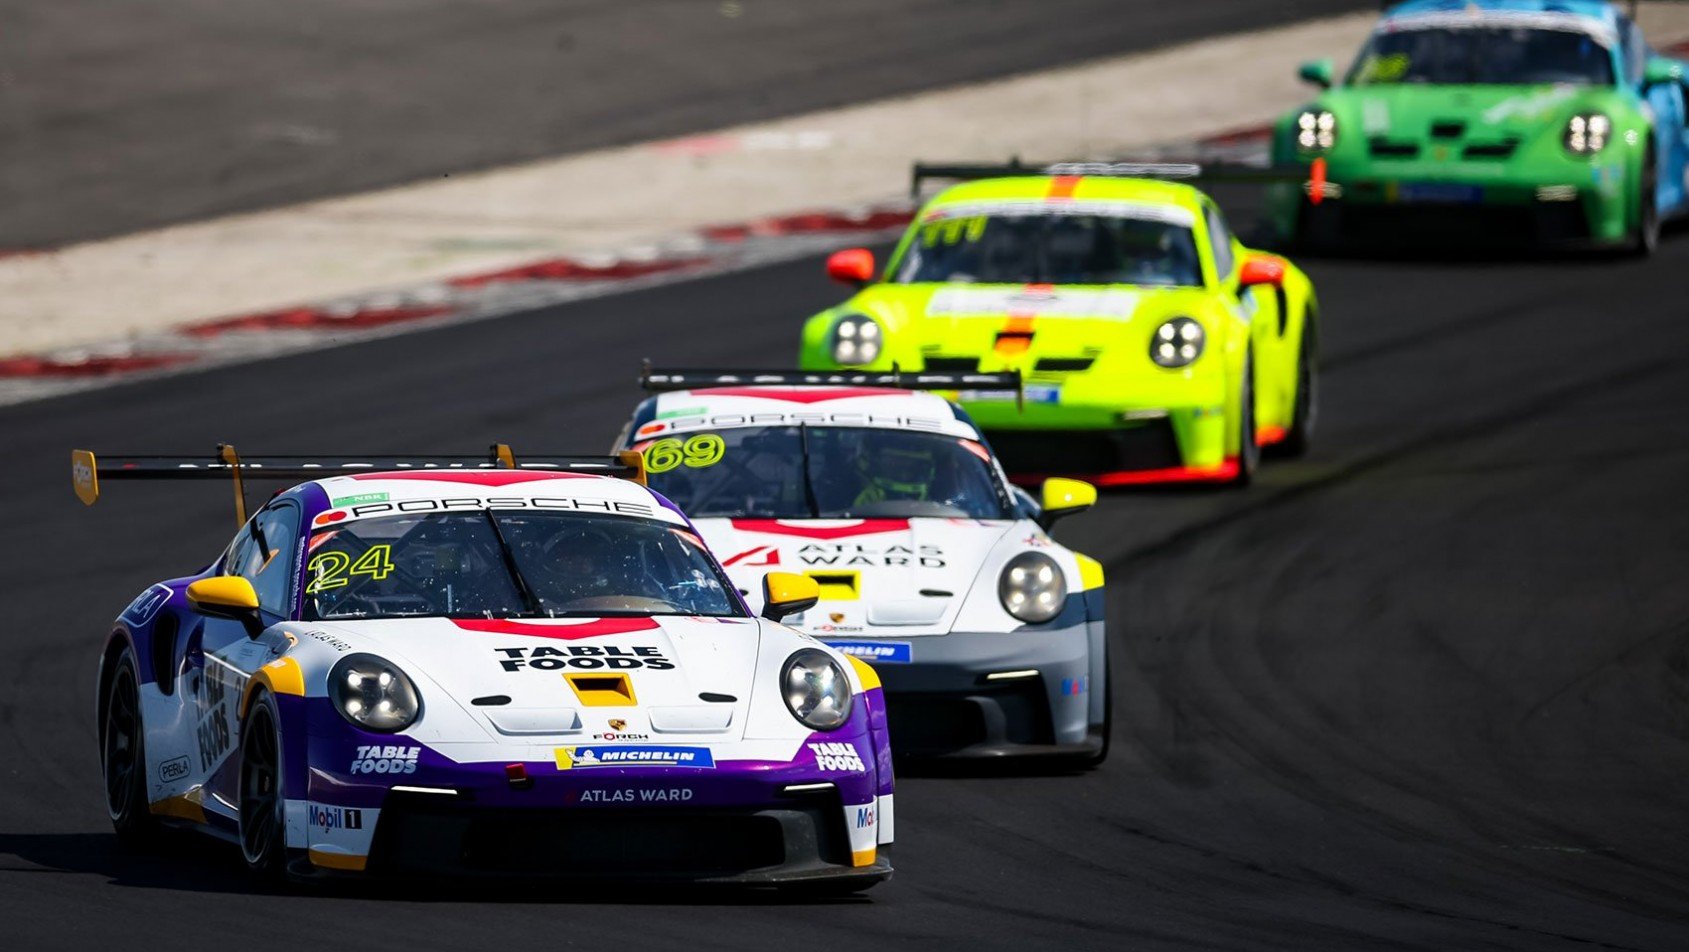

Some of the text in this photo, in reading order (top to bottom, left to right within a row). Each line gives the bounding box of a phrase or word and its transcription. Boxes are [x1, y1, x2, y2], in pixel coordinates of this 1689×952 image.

[671, 413, 942, 430] PORSCHE
[644, 433, 726, 474] 69
[352, 497, 653, 517] PORSCHE
[799, 544, 944, 555] ATLAS
[305, 544, 395, 594] 24
[799, 556, 947, 568] WARD
[494, 645, 663, 659] TABLE
[499, 657, 676, 672] FOODS
[356, 745, 421, 760] TABLE
[601, 750, 695, 762] MICHELIN
[807, 743, 858, 757] TABLE
[162, 760, 189, 778] PERLA
[351, 759, 418, 774] FOODS
[815, 756, 866, 772] FOODS
[580, 788, 693, 801] ATLAS WARD
[309, 805, 342, 828] Mobil
